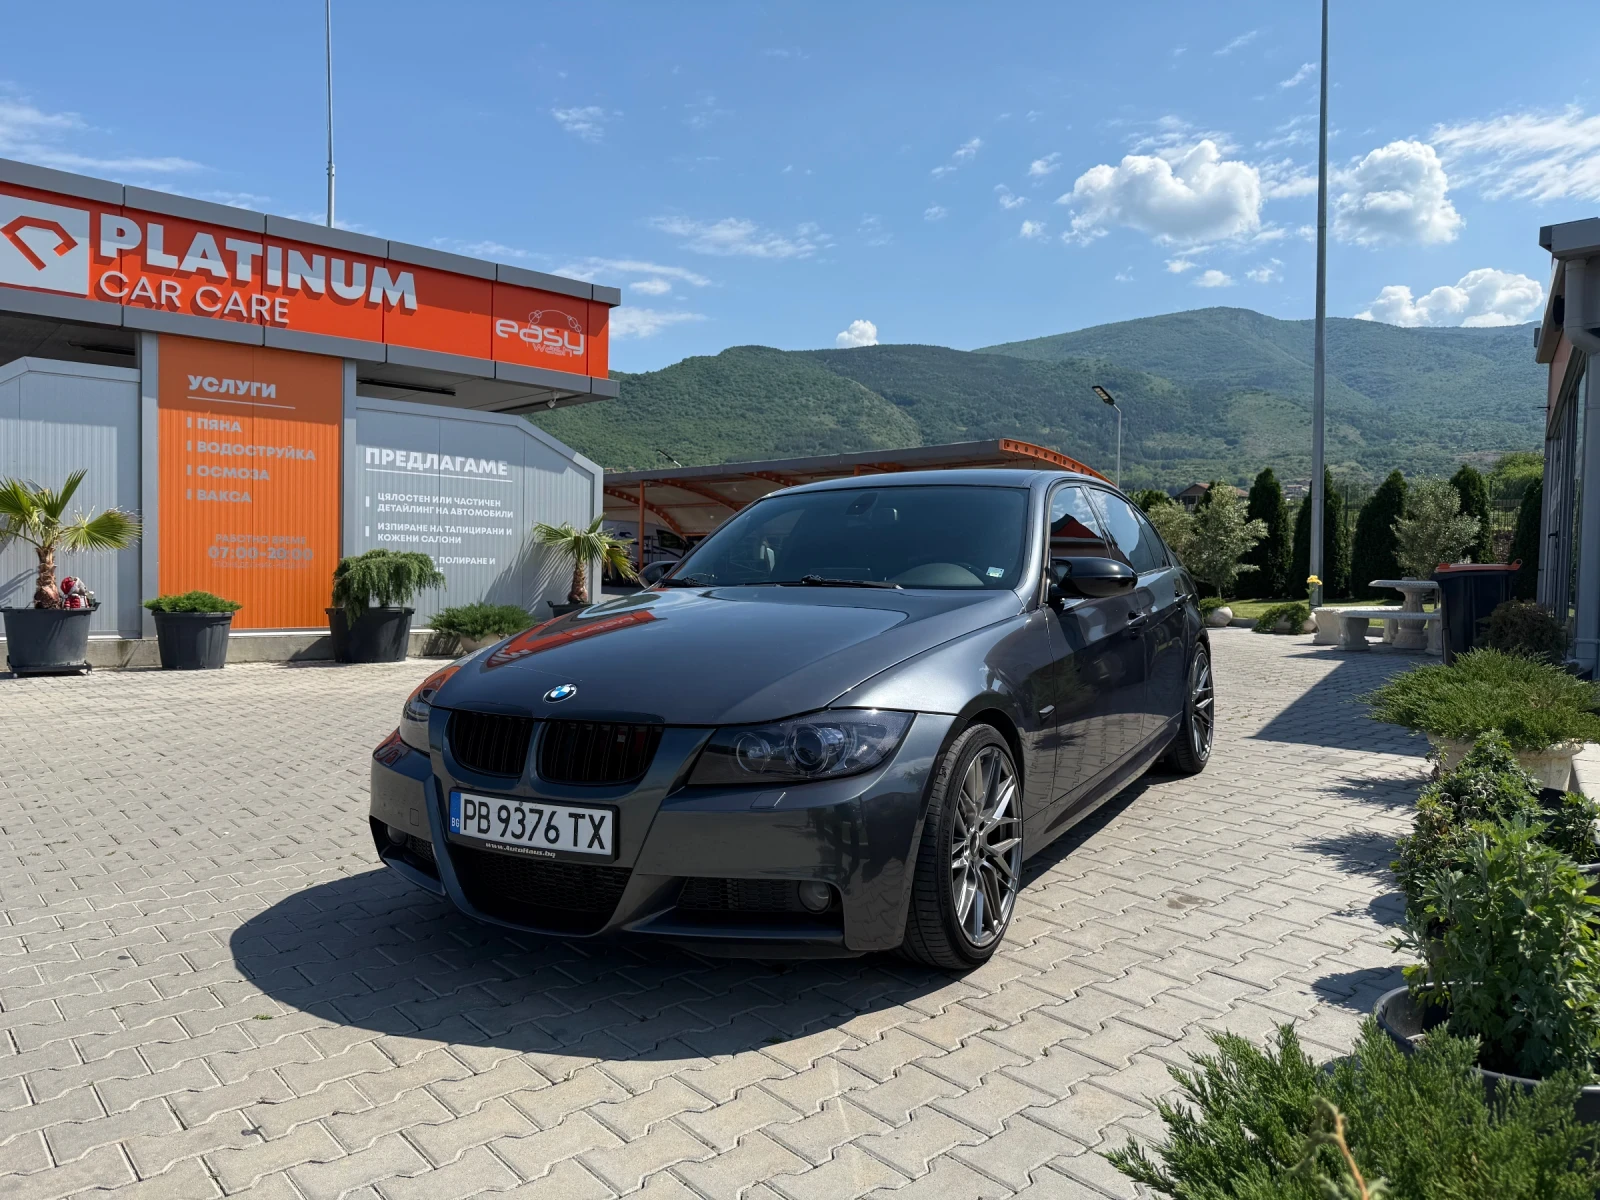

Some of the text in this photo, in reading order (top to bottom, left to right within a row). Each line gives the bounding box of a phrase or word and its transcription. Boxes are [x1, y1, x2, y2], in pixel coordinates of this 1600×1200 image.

[100, 212, 417, 310] PLATINUM
[100, 271, 289, 323] CAR CARE
[495, 319, 585, 355] easy
[187, 374, 276, 398] УСЛУГИ
[197, 417, 242, 433] ПЯНА
[197, 440, 316, 461] ВОДОСТРУЙКА
[365, 447, 508, 475] ПРЕДЛАГАМЕ
[196, 464, 270, 481] ОСМОЗА
[196, 488, 252, 503] ВАКСА
[377, 492, 501, 507] ЦЯЛОСТЕН ИЛИ ЧАСТИЧЕН
[377, 503, 514, 519] ДЕТАЙЛИНГ НА АВТОМОБИЛИ
[377, 522, 513, 536] ИЗПИРАНЕ НА ТАПИЦИРАНИ И
[215, 533, 307, 545] РАБОТНО ВРЕМЕ
[377, 533, 462, 545] КОЖЕНИ САЛОНИ
[438, 556, 488, 566] ПОЛИРАНЕ
[489, 557, 496, 566] И
[451, 817, 460, 829] BG
[463, 798, 606, 850] PB 9376 TX
[485, 842, 556, 859] www.AutoHaus.bg
